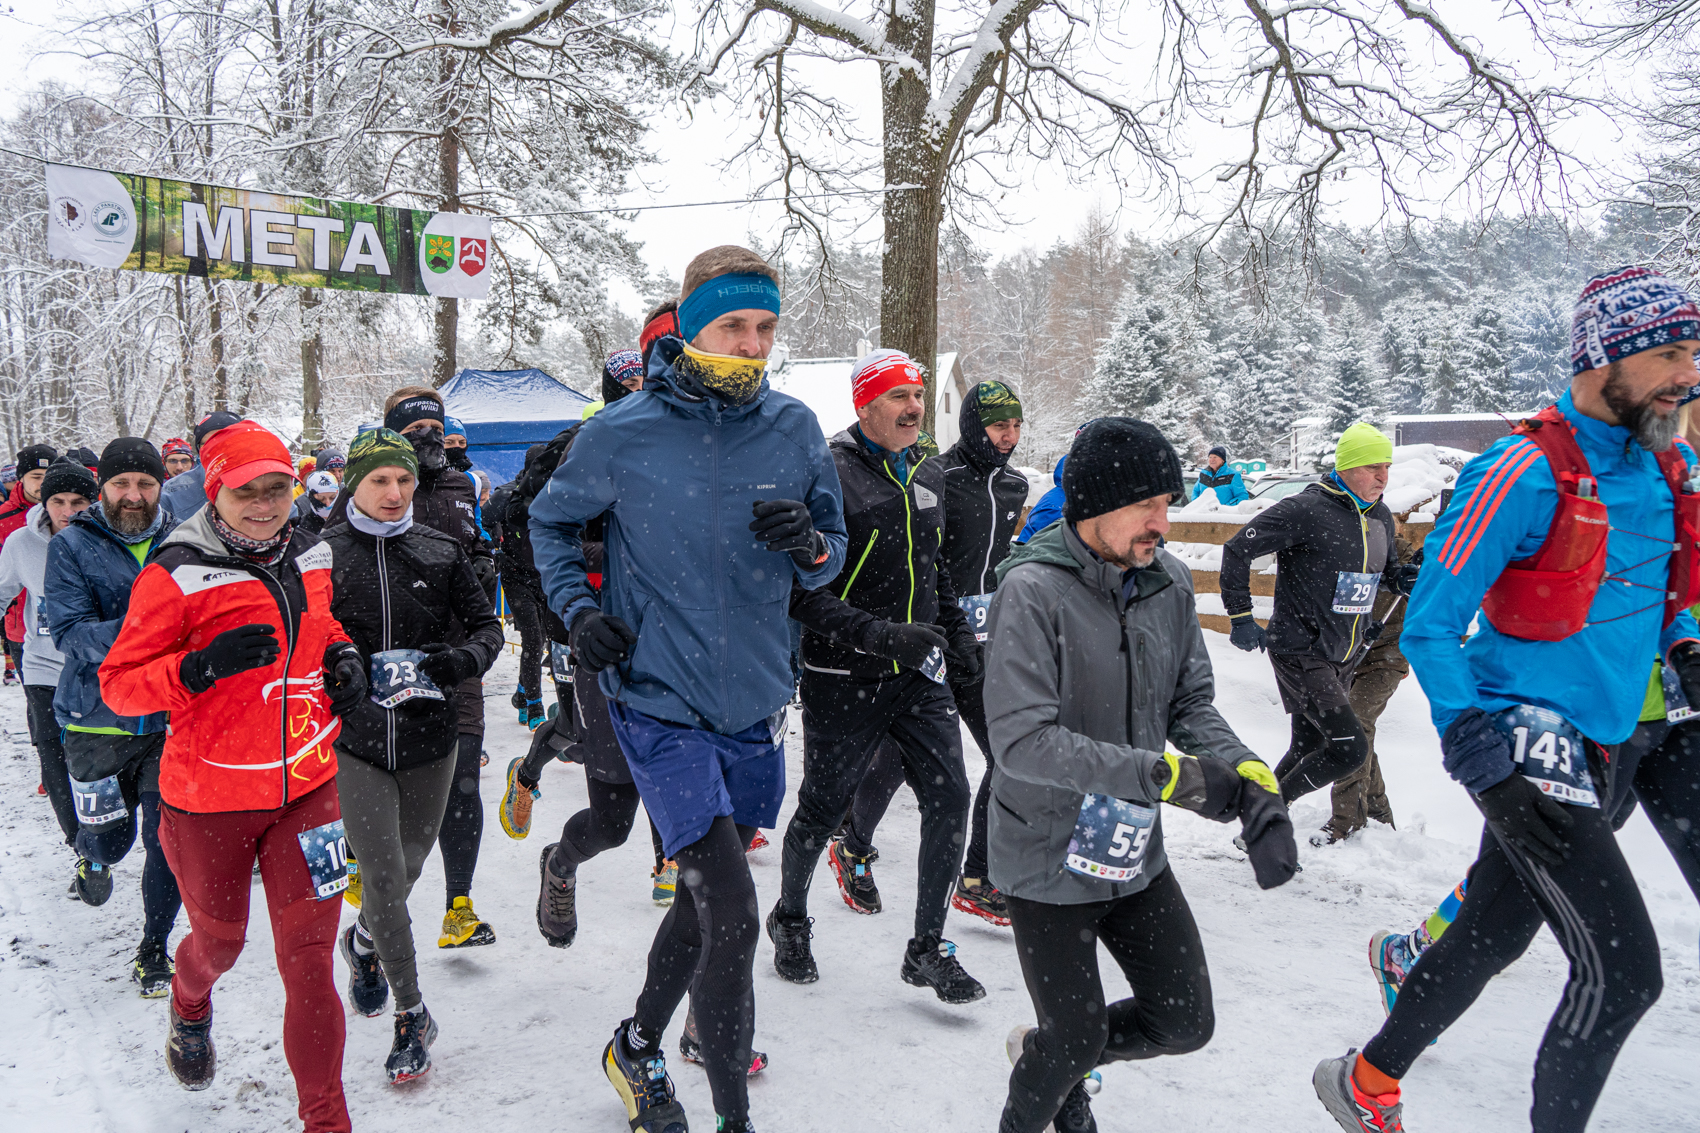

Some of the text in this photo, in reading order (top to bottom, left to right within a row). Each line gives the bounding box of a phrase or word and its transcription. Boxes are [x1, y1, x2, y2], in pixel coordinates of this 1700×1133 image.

[182, 200, 392, 276] META
[404, 400, 440, 410] Karpackie
[420, 404, 440, 413] Wilki
[1350, 583, 1372, 602] 29
[383, 661, 418, 688] 23
[1513, 726, 1573, 775] 143
[1107, 822, 1151, 860] 55
